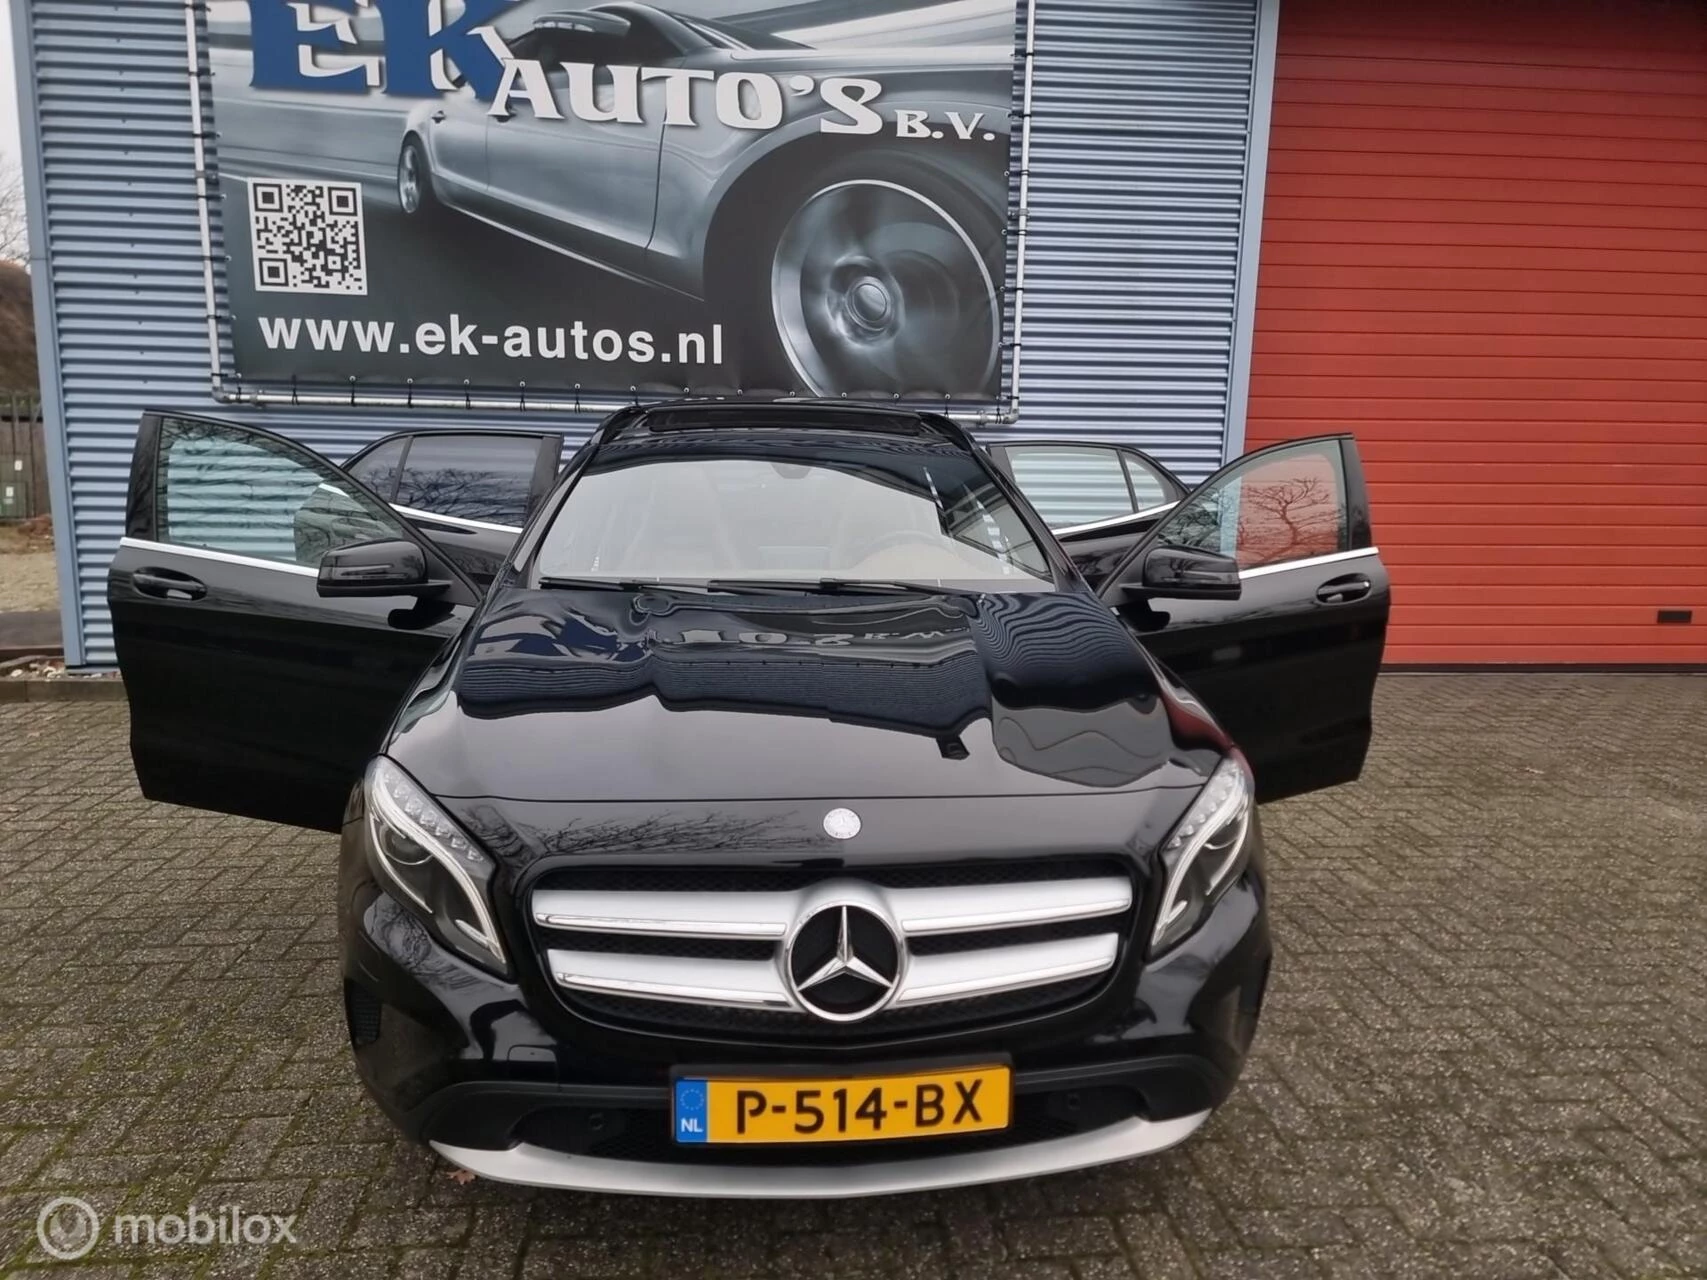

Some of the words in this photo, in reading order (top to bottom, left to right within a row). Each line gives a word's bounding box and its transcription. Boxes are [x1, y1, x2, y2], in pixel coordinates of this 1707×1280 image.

[895, 109, 996, 141] B.V.
[257, 313, 723, 365] www.ek-autos.nl
[680, 1117, 704, 1133] NL
[736, 1079, 983, 1135] P-514-BX
